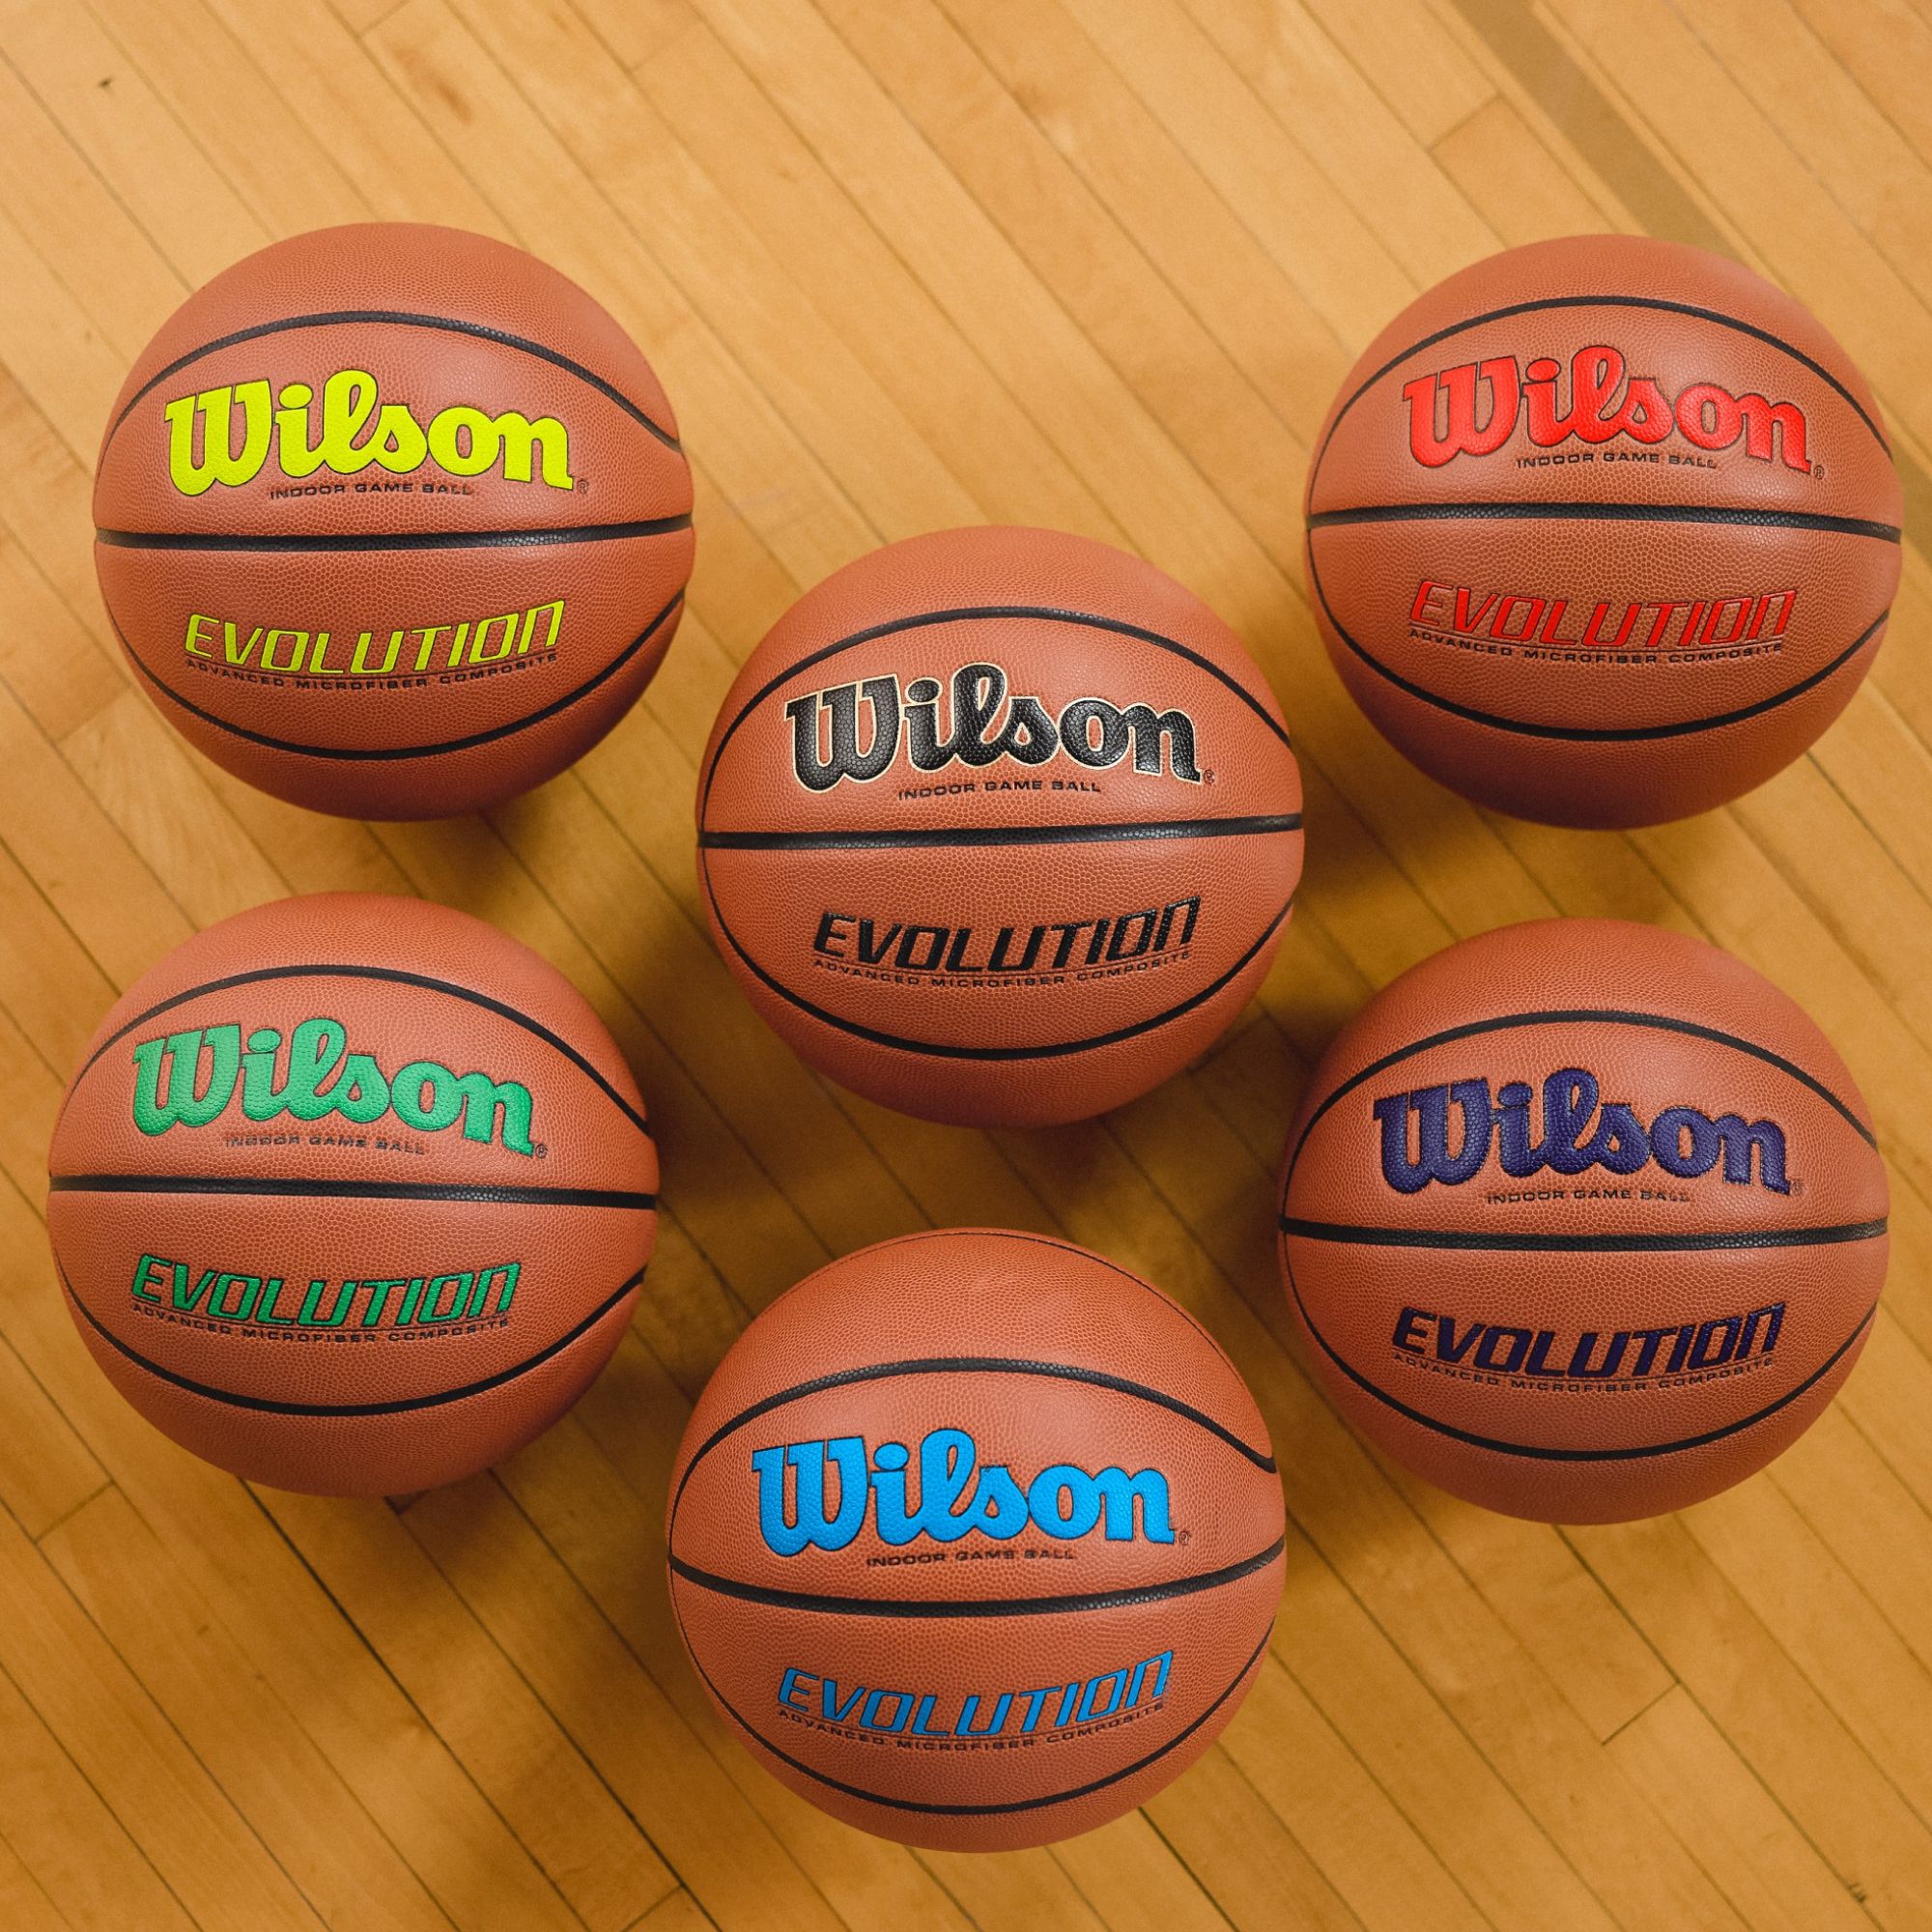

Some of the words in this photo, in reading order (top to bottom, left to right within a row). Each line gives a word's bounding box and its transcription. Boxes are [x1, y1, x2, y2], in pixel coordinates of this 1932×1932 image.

[164, 369, 573, 497] Wilson
[1402, 344, 1811, 475] Wilson
[1517, 454, 1594, 469] INDOOR
[1603, 453, 1659, 463] GAME
[1668, 455, 1717, 469] BALL
[270, 485, 346, 499] INDOOR
[355, 483, 413, 494] GAME
[423, 484, 471, 496] BALL
[185, 599, 565, 674] EVOLUTION
[1409, 580, 1797, 647] EVOLUTION
[187, 660, 284, 687] ADVANCED
[297, 679, 427, 690] MICROFIBER
[439, 654, 557, 684] COMPOSITE
[1409, 630, 1513, 656] ADVANCED
[1524, 650, 1657, 664] MICROFIBER
[1669, 642, 1782, 663] COMPOSITE
[784, 662, 1202, 793] Wilson
[898, 781, 976, 800] INDOOR
[984, 781, 1042, 790] GAME
[1052, 781, 1101, 792] BALL
[812, 895, 1201, 972] EVOLUTION
[815, 960, 919, 985] ADVANCED
[931, 976, 1065, 988] MICROFIBER
[1077, 952, 1189, 981] COMPOSITE
[133, 1017, 535, 1157] Wilson
[225, 1135, 299, 1148] INDOOR
[309, 1137, 367, 1148] GAME
[376, 1141, 424, 1154] BALL
[1373, 1067, 1791, 1195] Wilson
[1487, 1190, 1565, 1205] INDOOR
[1574, 1190, 1631, 1200] GAME
[1639, 1191, 1689, 1202] BALL
[132, 1254, 522, 1326] EVOLUTION
[133, 1304, 231, 1334] ADVANCED
[242, 1329, 375, 1342] MICROFIBER
[388, 1320, 508, 1341] COMPOSITE
[1392, 1302, 1786, 1378] EVOLUTION
[1394, 1354, 1500, 1386] ADVANCED
[1511, 1380, 1646, 1392] MICROFIBER
[1660, 1358, 1773, 1389] COMPOSITE
[751, 1428, 1175, 1558] Wilson
[867, 1553, 946, 1567] INDOOR
[955, 1550, 1015, 1561] GAME
[1024, 1549, 1073, 1560] BALL
[778, 1650, 1174, 1737] EVOLUTION
[779, 1709, 885, 1746] ADVANCED
[896, 1739, 1035, 1751] MICROFIBER
[1046, 1704, 1163, 1742] COMPOSITE
